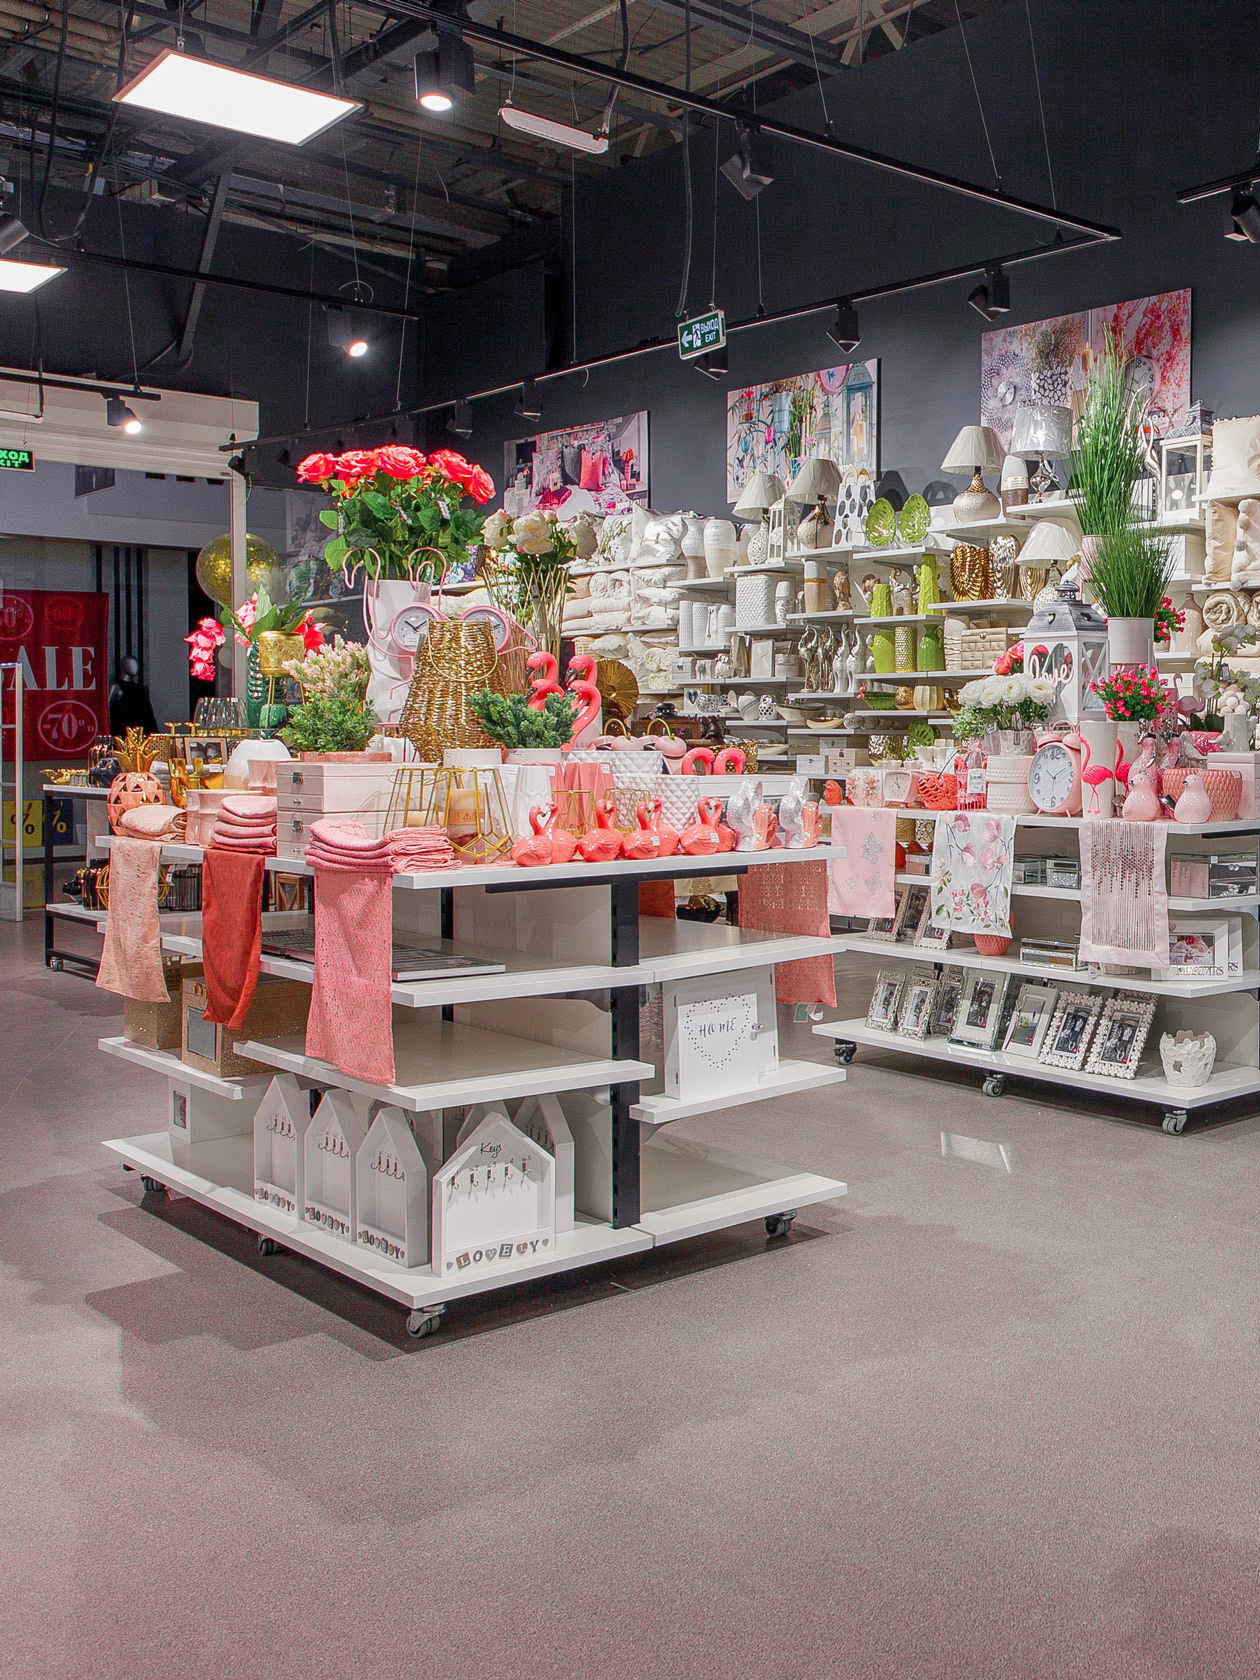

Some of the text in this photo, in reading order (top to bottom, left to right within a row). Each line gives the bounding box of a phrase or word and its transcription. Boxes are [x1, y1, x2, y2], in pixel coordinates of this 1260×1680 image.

[705, 332, 717, 343] EXIT
[0, 645, 96, 691] ALE
[43, 713, 94, 738] -70%
[480, 1142, 502, 1159] Keys
[457, 1240, 540, 1269] LOVELY
